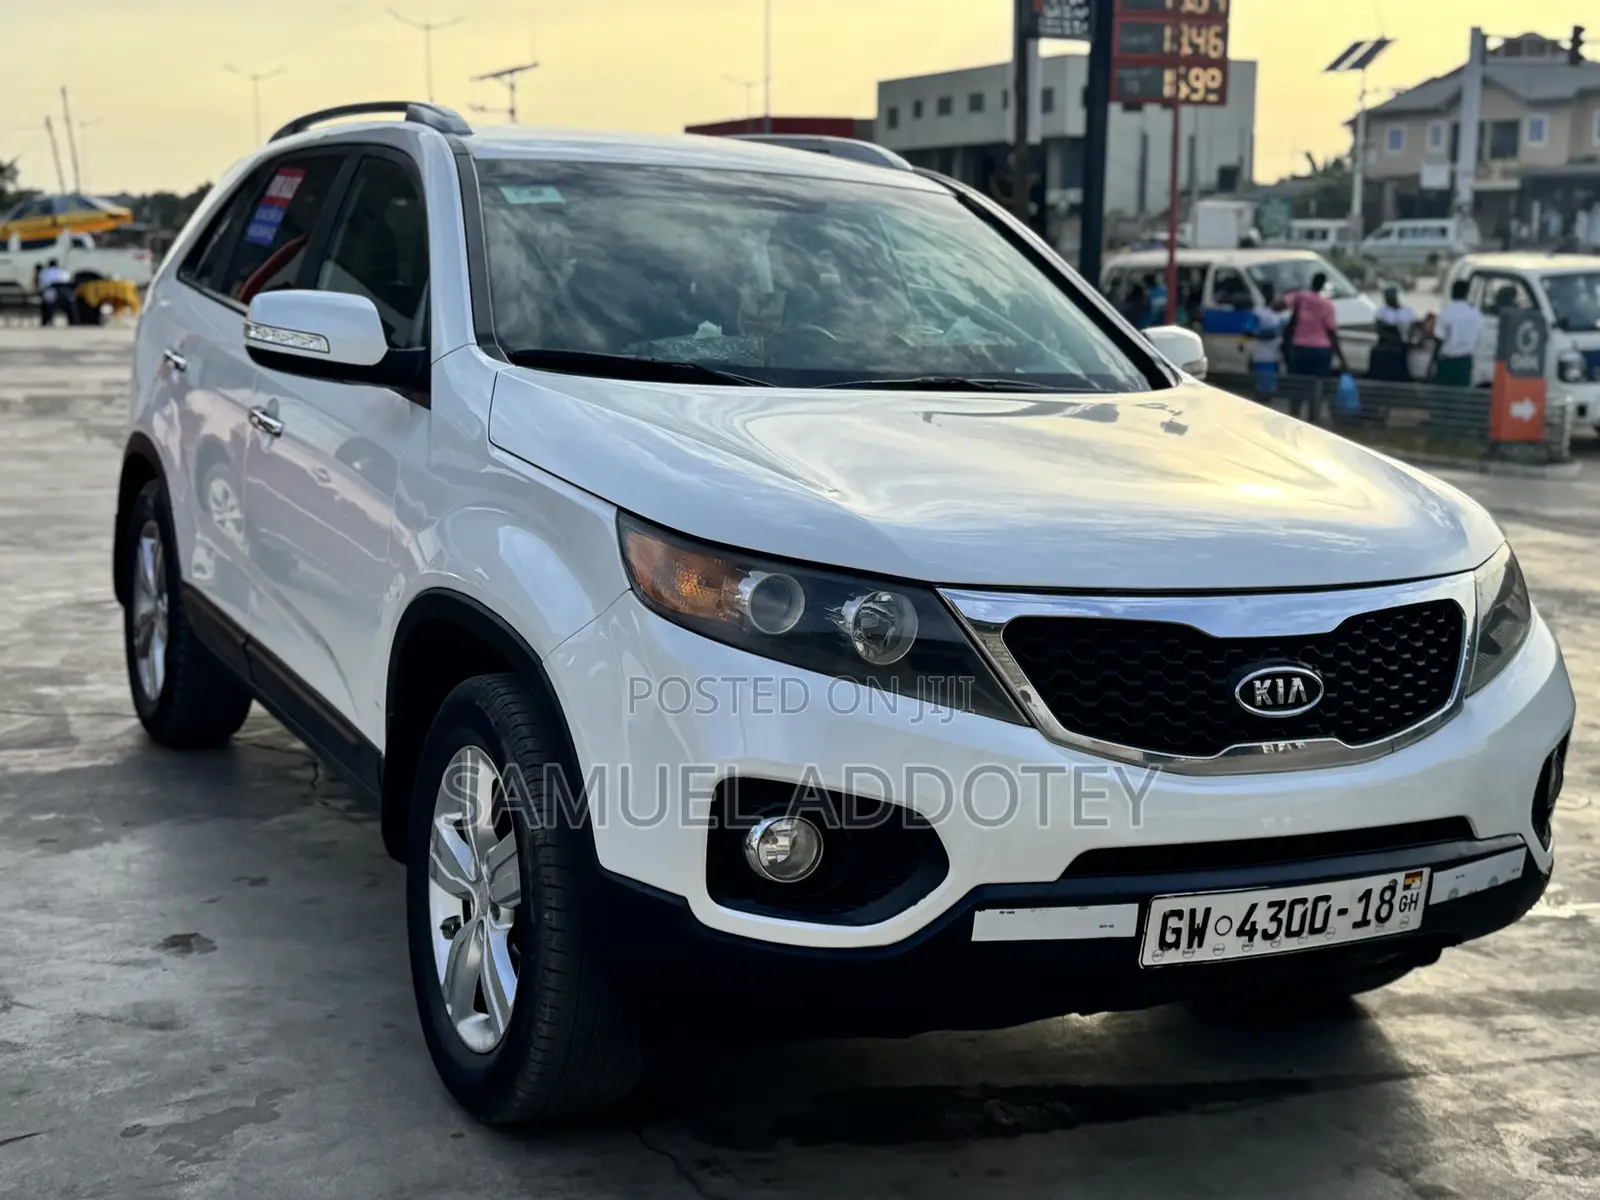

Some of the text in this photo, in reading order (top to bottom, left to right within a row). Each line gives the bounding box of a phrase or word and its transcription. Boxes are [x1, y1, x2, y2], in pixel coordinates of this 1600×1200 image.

[1253, 677, 1308, 706] KIA
[1398, 891, 1420, 913] GH
[1158, 884, 1397, 952] GW 4300-18
